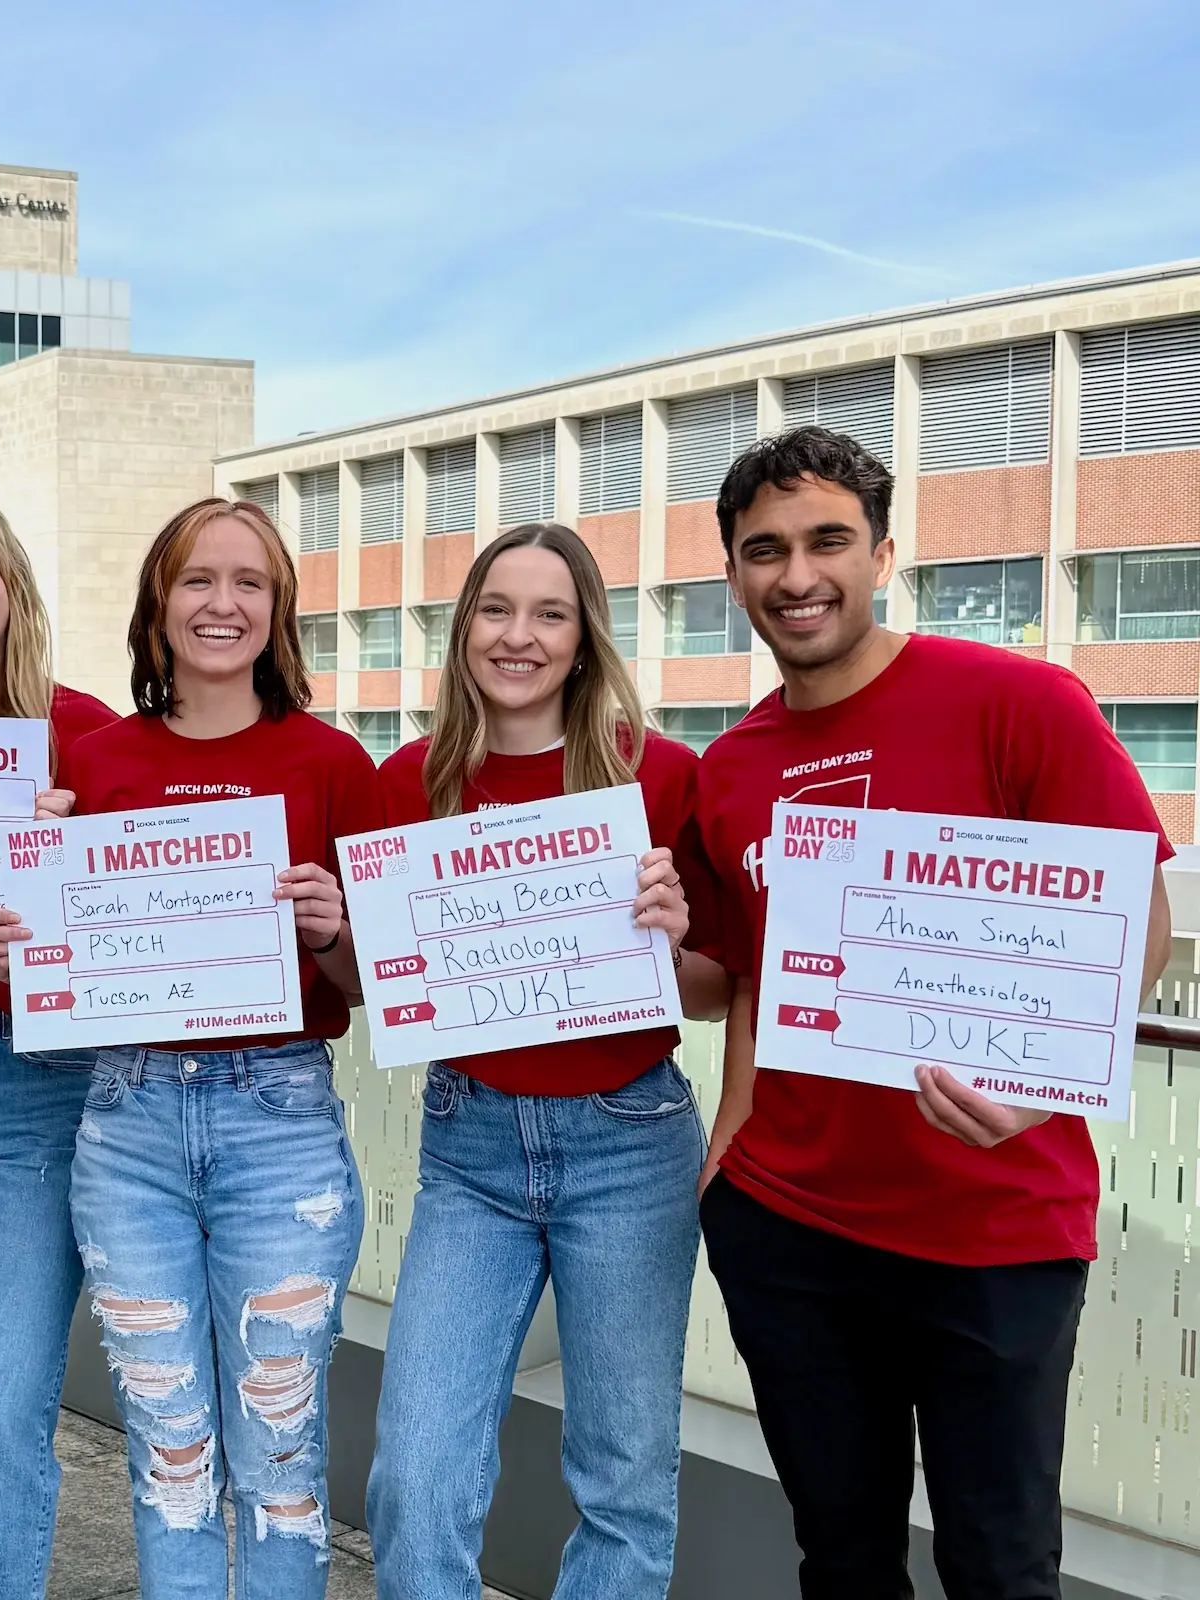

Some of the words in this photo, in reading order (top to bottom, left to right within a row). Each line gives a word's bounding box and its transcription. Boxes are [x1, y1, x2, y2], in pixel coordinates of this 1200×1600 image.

[17, 193, 67, 211] Center
[782, 761, 819, 779] MATCH
[821, 755, 843, 769] DAY
[844, 750, 873, 764] 2025
[165, 785, 200, 796] MATCH
[203, 785, 223, 795] DAY
[224, 785, 251, 796] 2025
[484, 821, 506, 829] SCHOOL
[515, 814, 541, 823] MEDICINE
[785, 815, 856, 840] MATCH
[8, 828, 63, 851] MATCH
[347, 836, 406, 863] MATCH
[784, 837, 824, 860] DAY
[826, 841, 855, 863] 25
[957, 832, 983, 840] SCHOOL
[996, 835, 1028, 844] MEDICINE
[10, 849, 41, 870] DAY
[44, 847, 65, 866] 25
[86, 848, 96, 873] I
[104, 832, 252, 872] MATCHED!
[432, 853, 443, 880] I
[451, 823, 612, 878] MATCHED!
[351, 860, 383, 882] DAY
[387, 856, 409, 876] 25
[883, 850, 893, 881] I
[906, 852, 1104, 903] MATCHED!
[71, 895, 129, 919] Sarah
[147, 890, 254, 914] Montgomery
[438, 898, 504, 928] Abby
[514, 873, 612, 911] Beard
[876, 906, 959, 943] Ahaan
[980, 917, 1066, 954] Singhal
[28, 949, 64, 962] INTO
[89, 934, 164, 960] PSYCH
[440, 932, 581, 976] Radiology
[379, 959, 418, 976] INTO
[788, 955, 834, 972] INTO
[40, 996, 58, 1007] AT
[84, 987, 149, 1009] Tucson
[168, 982, 195, 1000] AZ
[468, 966, 597, 1026] DUKE
[893, 967, 1051, 1018] Anesthesiology
[184, 1012, 287, 1029] #IUMedMatch
[398, 1007, 417, 1021] AT
[556, 1005, 666, 1031] #IUMedMatch
[795, 1012, 818, 1025] AT
[906, 1011, 1050, 1066] DUKE
[972, 1076, 1108, 1108] #IUMedMatch
